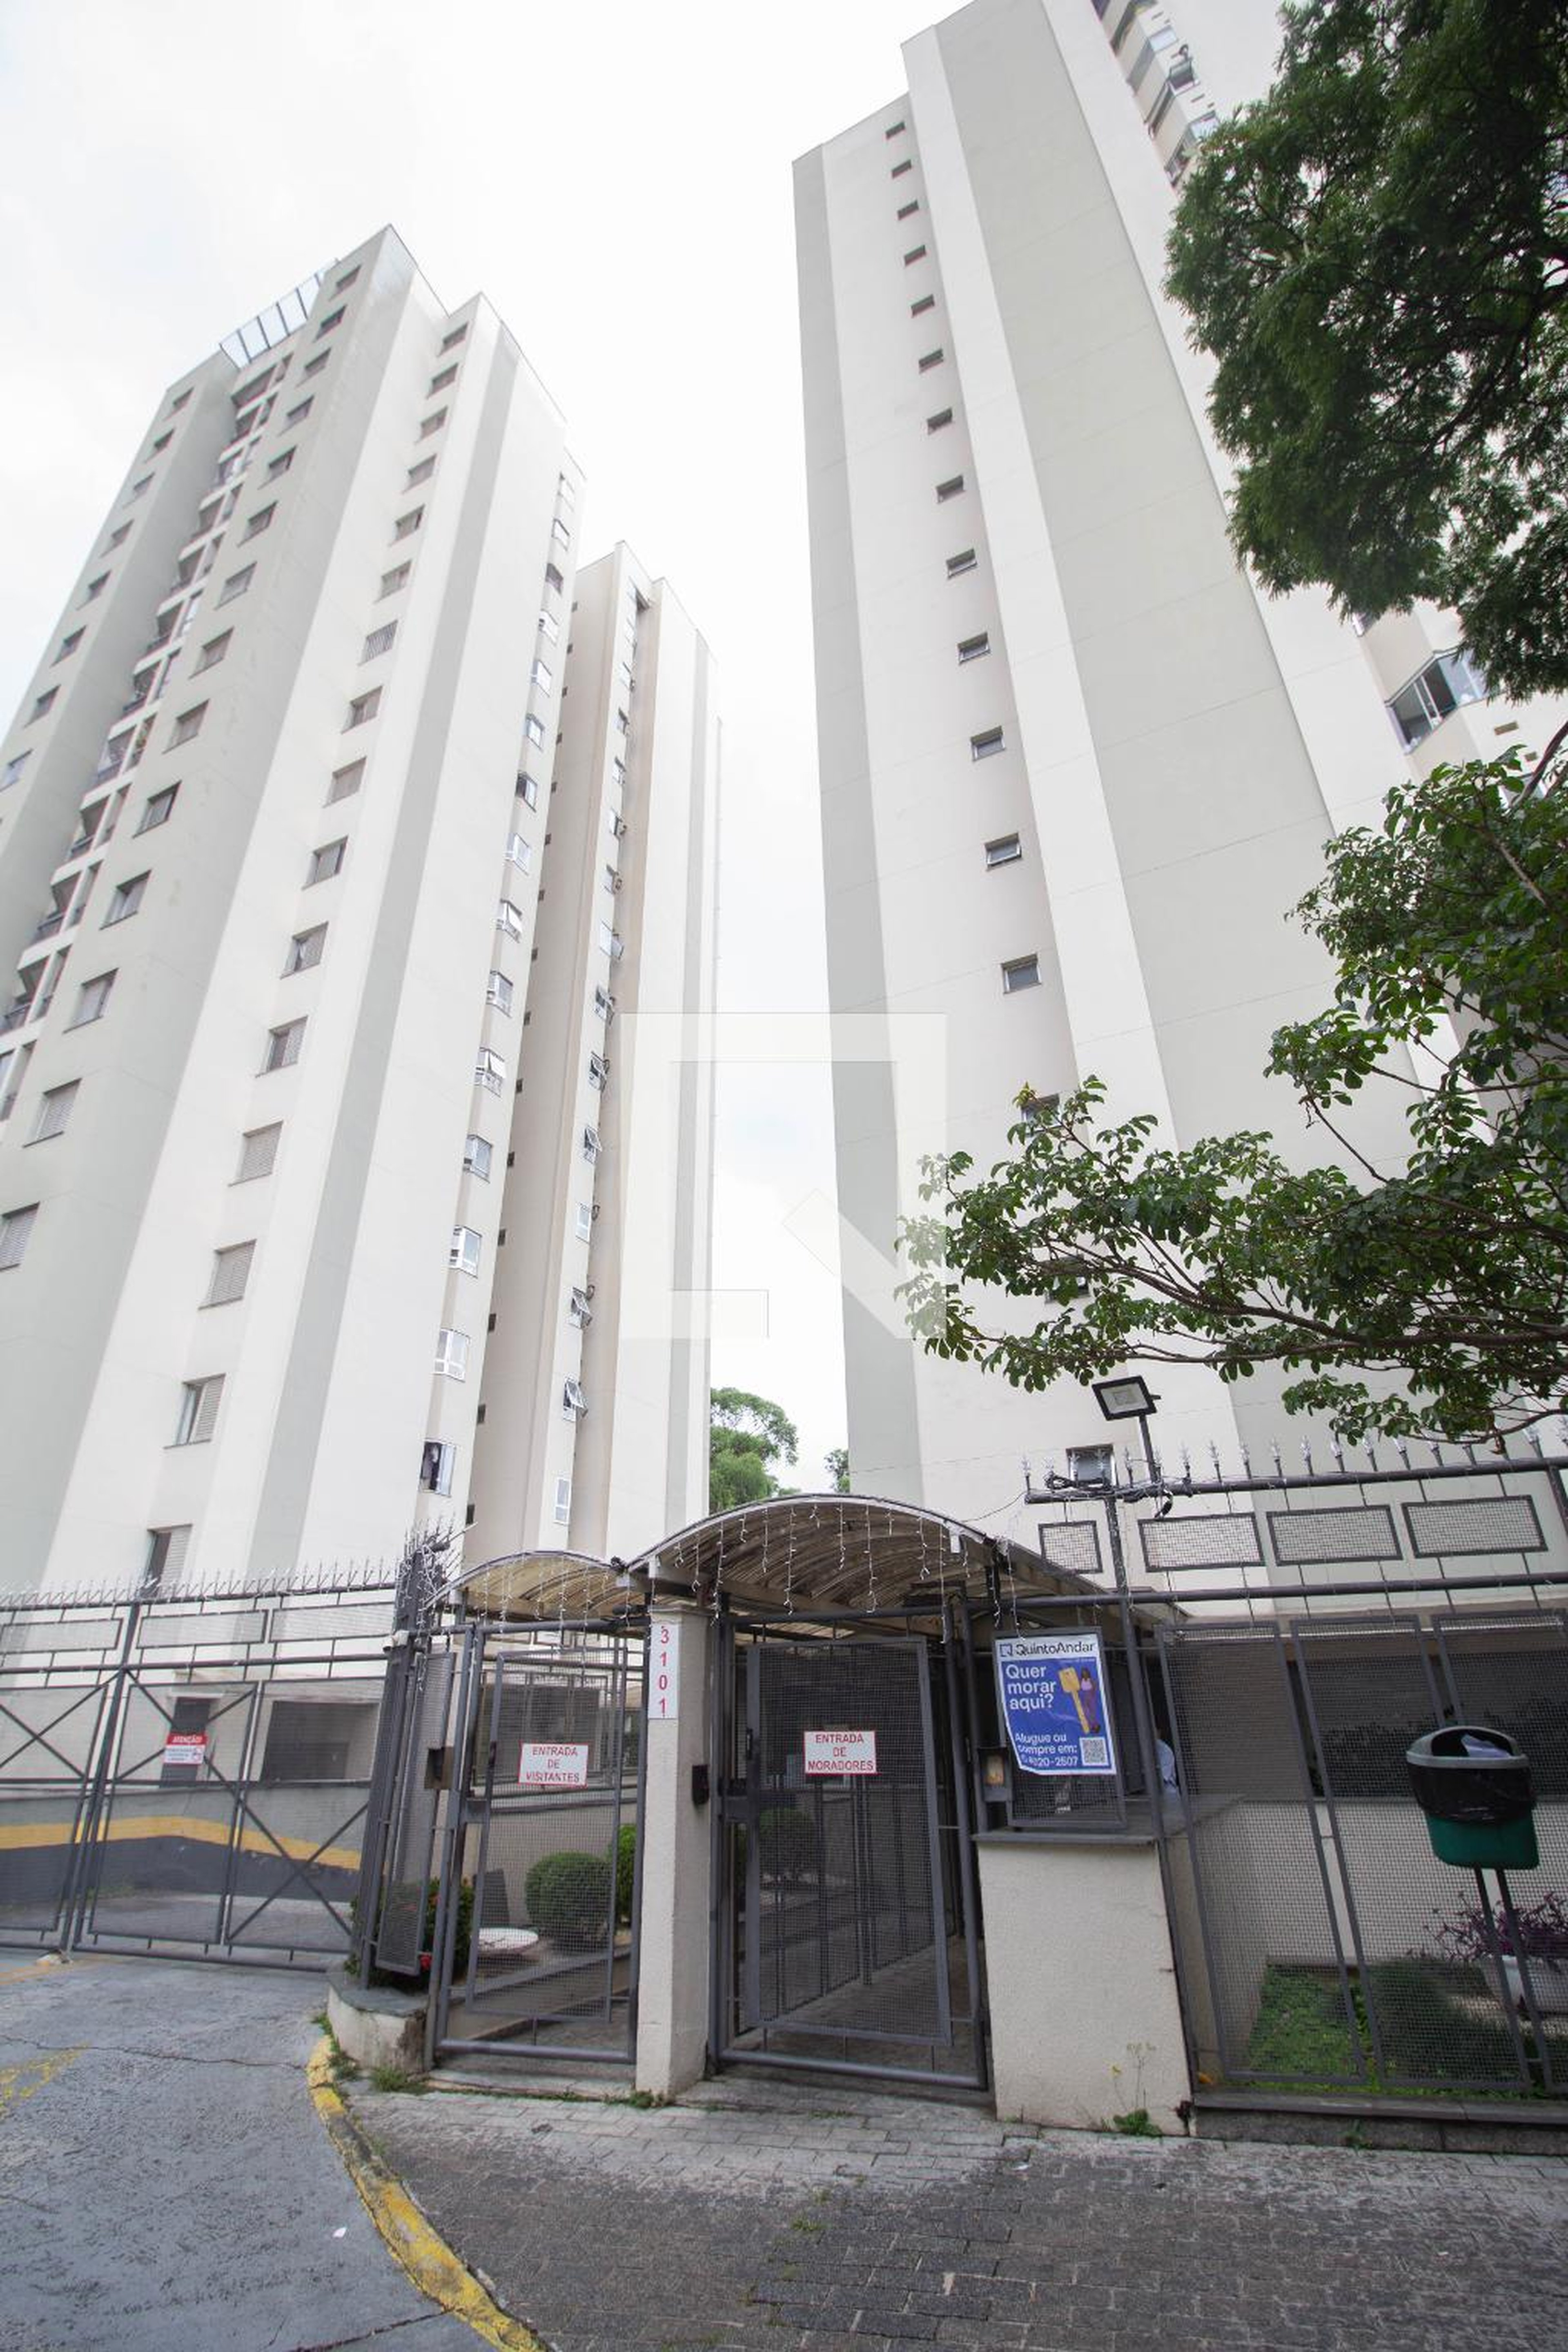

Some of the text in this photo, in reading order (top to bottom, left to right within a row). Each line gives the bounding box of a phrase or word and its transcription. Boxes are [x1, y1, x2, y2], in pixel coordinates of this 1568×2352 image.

[1016, 1641, 1094, 1656] QuintoAndar
[659, 1628, 669, 1714] 3101
[1006, 1664, 1047, 1679] Quer
[1007, 1681, 1056, 1694] morar
[1010, 1693, 1054, 1712] aqui?
[815, 1733, 864, 1743] ENTRADA
[1016, 1733, 1067, 1745] Alugue ou
[532, 1746, 578, 1756] ENTRADA
[833, 1746, 847, 1757] DE
[1058, 1745, 1077, 1753] em:
[548, 1759, 560, 1769] DE
[808, 1760, 873, 1771] MORADORES
[526, 1771, 579, 1782] VISITANTES
